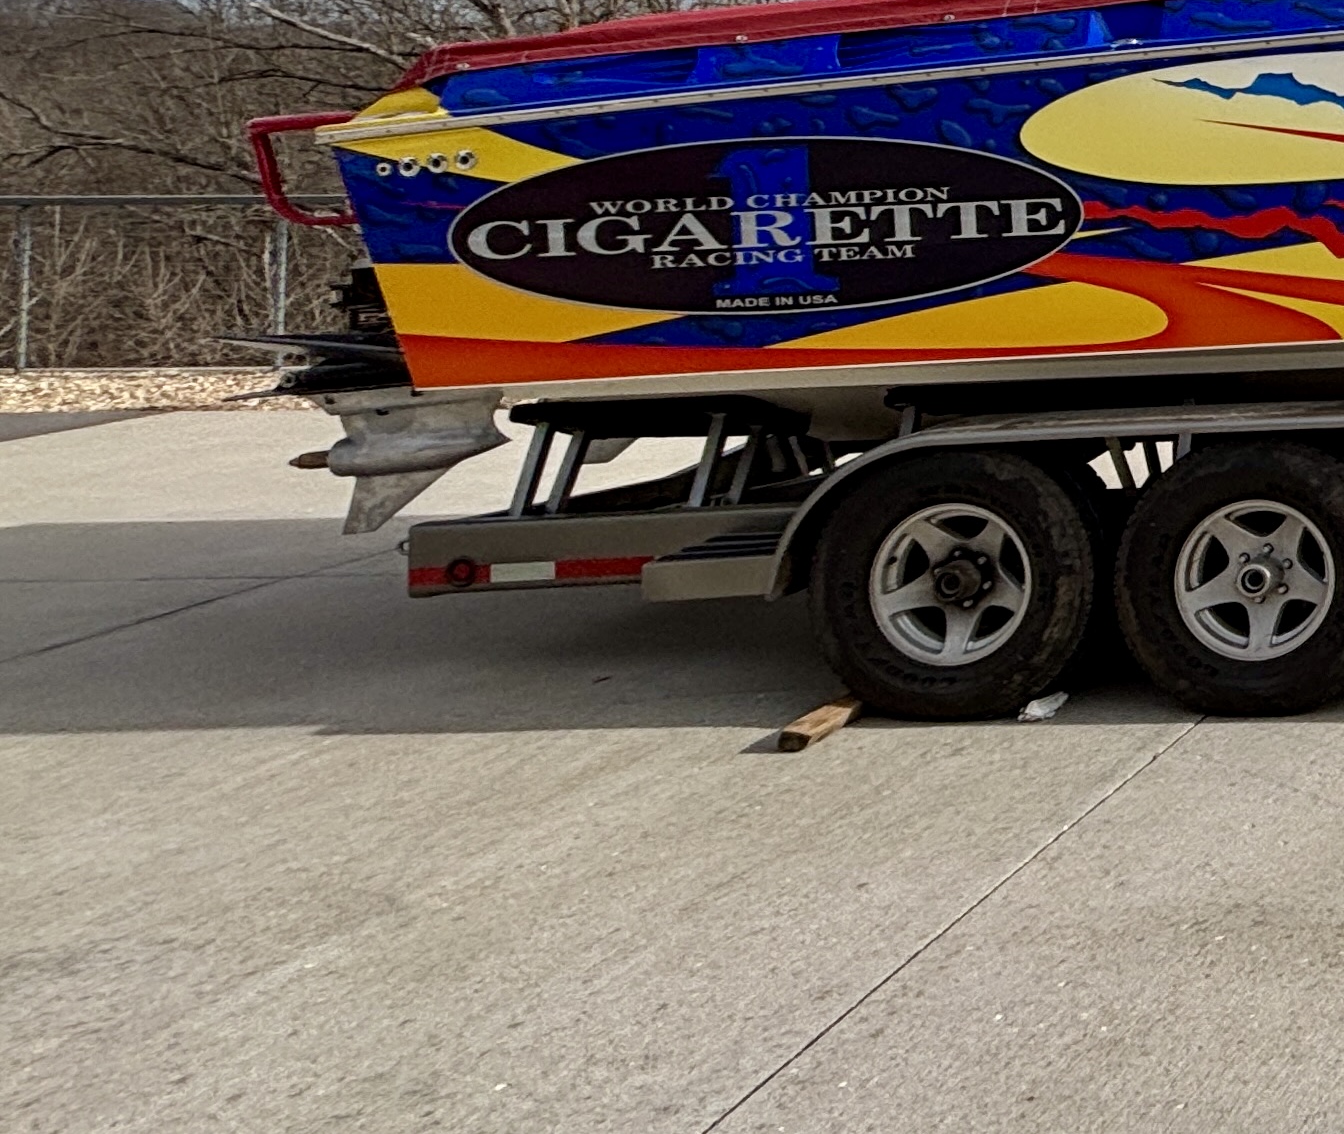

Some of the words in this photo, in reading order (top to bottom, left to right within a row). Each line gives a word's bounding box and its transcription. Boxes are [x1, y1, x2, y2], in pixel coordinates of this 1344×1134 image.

[589, 196, 735, 215] WORLD
[747, 186, 950, 209] CHAMPION
[467, 197, 1067, 260] CIGARETTE
[650, 248, 805, 270] RACING
[813, 244, 916, 263] TEAM
[715, 296, 770, 309] MADE
[774, 296, 795, 307] IN
[798, 294, 838, 306] USA
